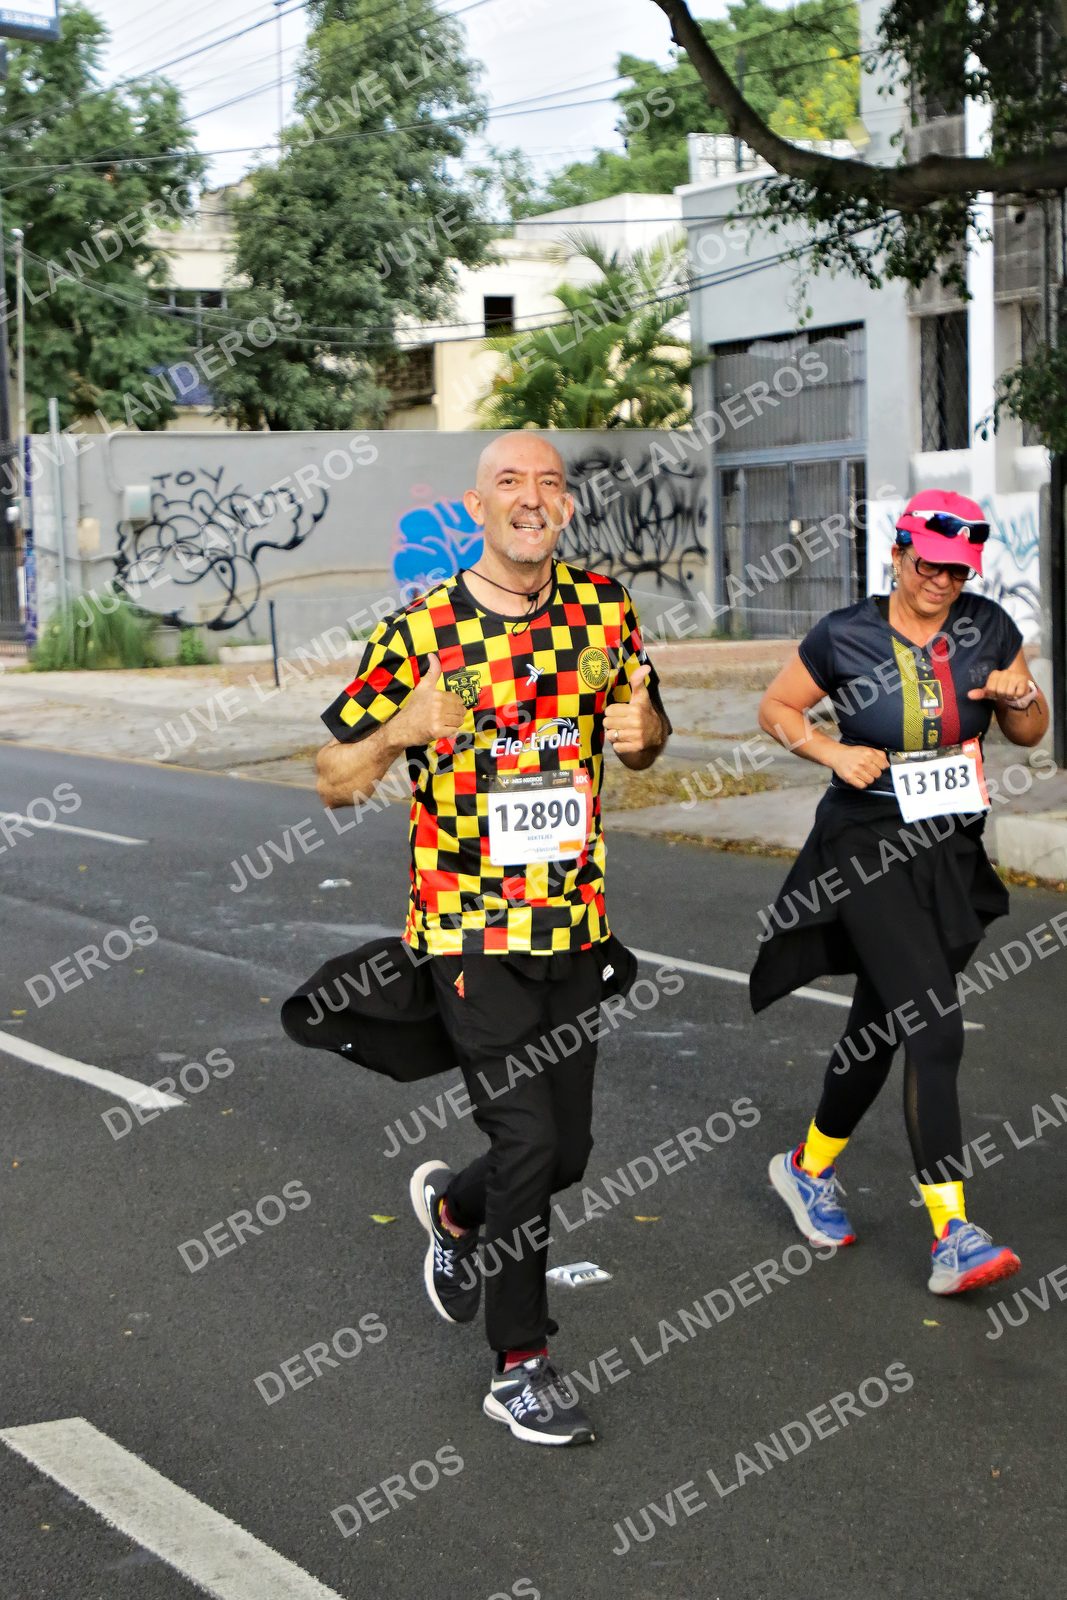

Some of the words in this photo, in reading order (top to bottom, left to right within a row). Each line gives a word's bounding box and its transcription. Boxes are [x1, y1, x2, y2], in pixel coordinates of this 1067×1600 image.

[152, 465, 224, 493] TOY
[490, 728, 580, 758] Electrolit
[898, 764, 970, 796] 13183
[495, 798, 580, 832] 12890
